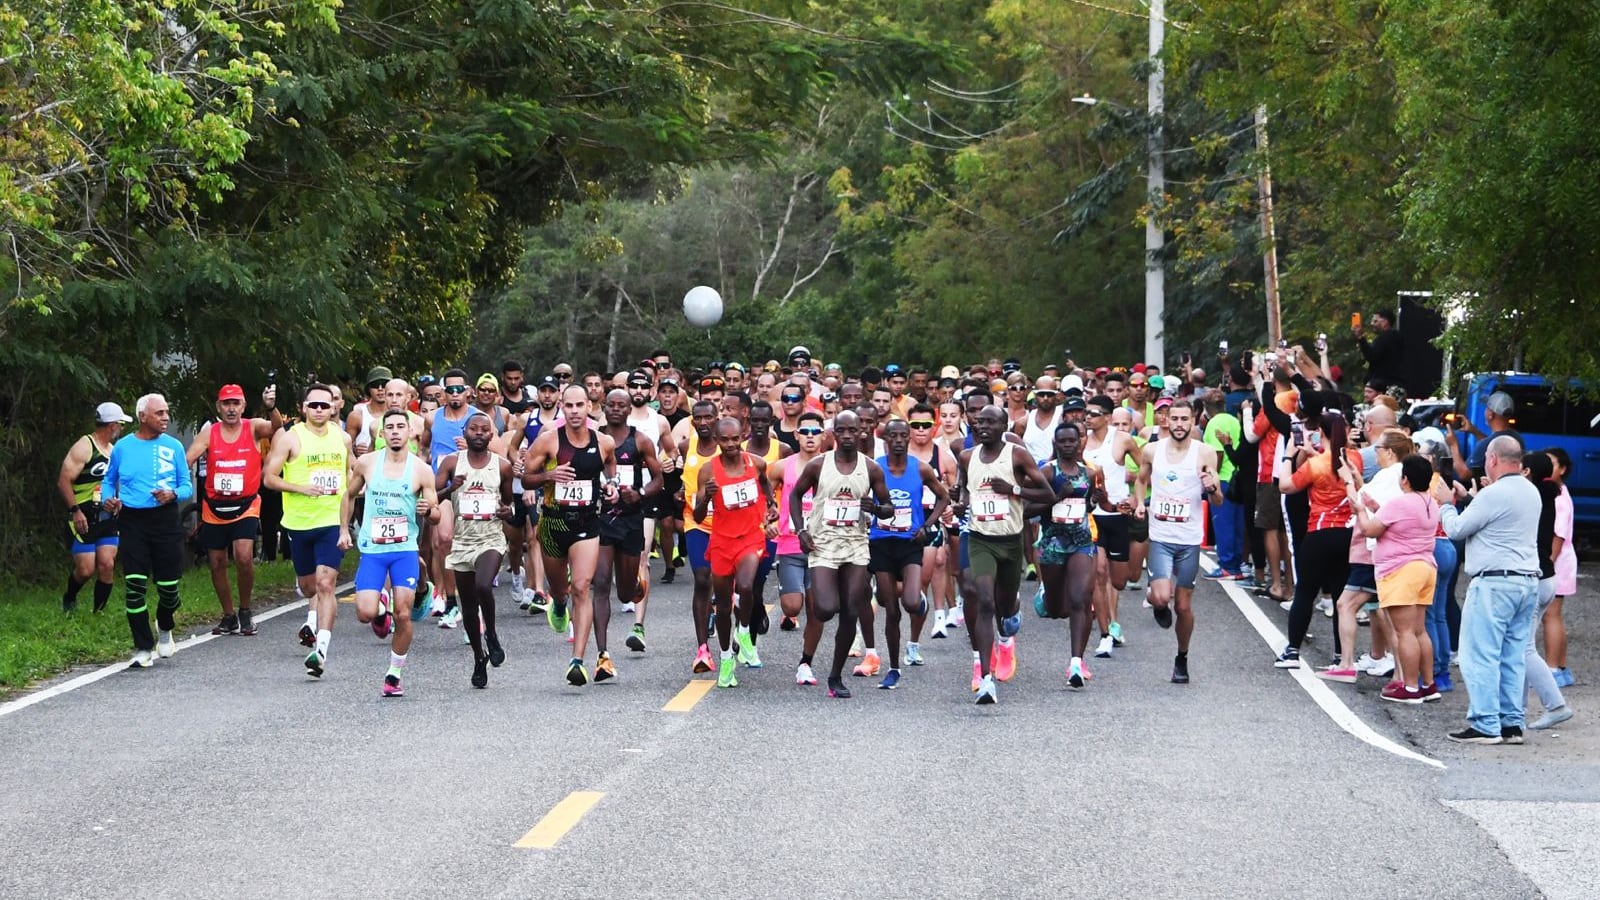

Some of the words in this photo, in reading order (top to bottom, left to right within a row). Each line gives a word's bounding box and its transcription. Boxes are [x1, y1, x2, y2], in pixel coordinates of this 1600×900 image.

[220, 478, 232, 490] 66
[313, 476, 338, 489] 2046
[562, 486, 583, 500] 743
[734, 488, 748, 501] 15
[472, 500, 480, 513] 3
[836, 507, 848, 519] 17
[982, 500, 995, 514] 10
[1065, 504, 1072, 517] 7
[1159, 502, 1185, 516] 1917
[889, 515, 897, 527] 2
[381, 524, 396, 538] 25
